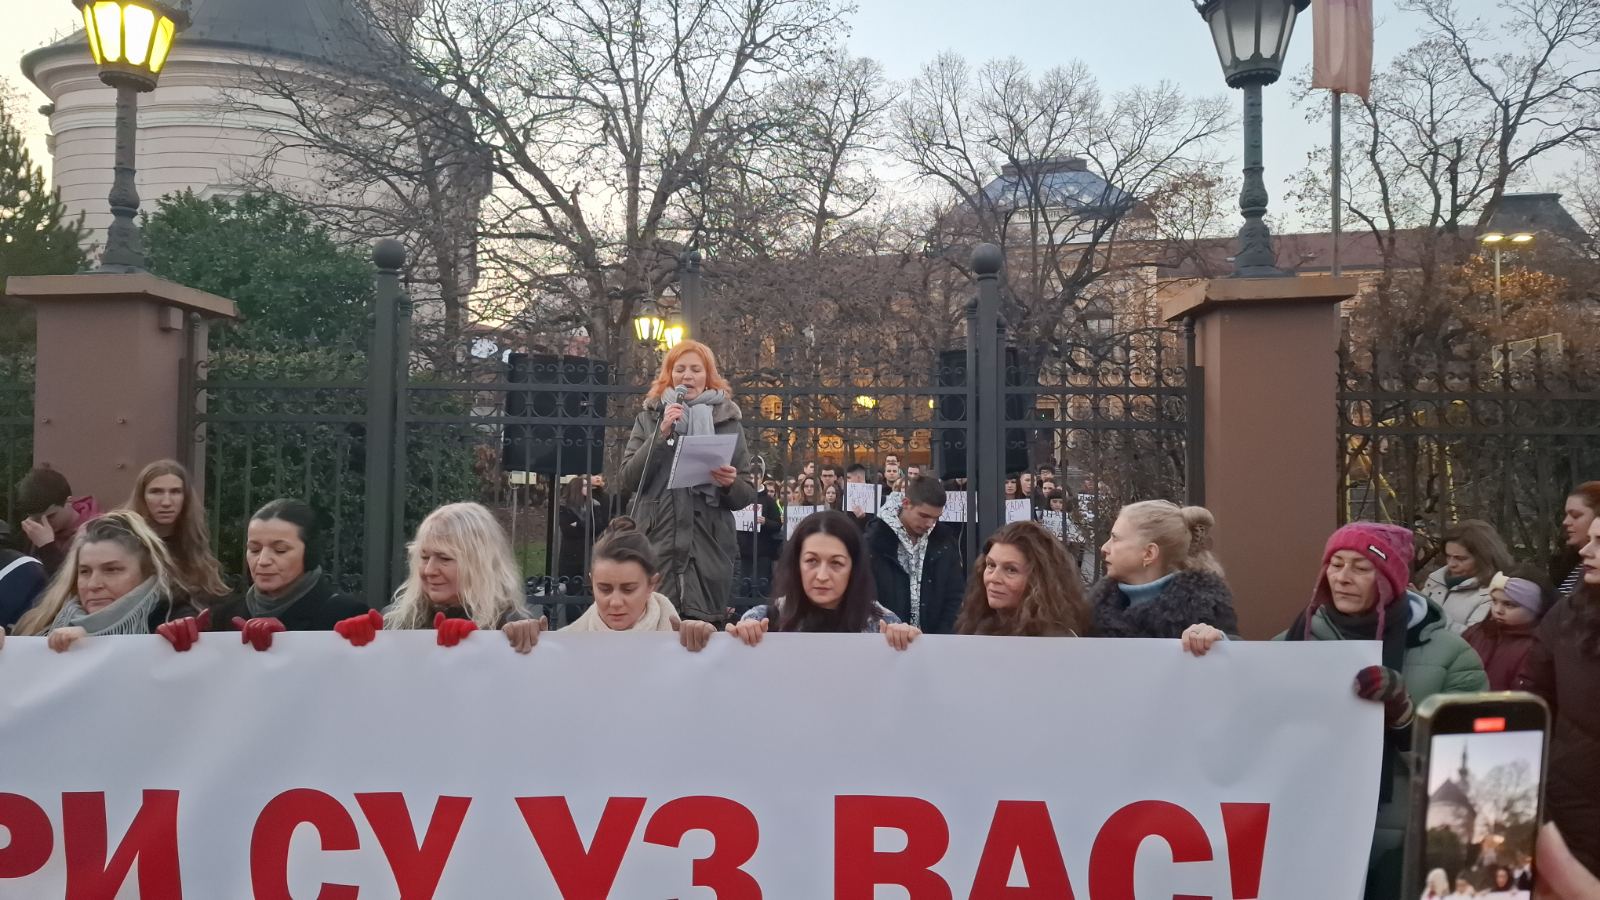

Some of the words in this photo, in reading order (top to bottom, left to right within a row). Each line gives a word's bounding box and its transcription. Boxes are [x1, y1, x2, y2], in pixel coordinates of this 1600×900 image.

[251, 789, 471, 900] СУ
[516, 795, 763, 900] УЗ
[835, 795, 1270, 900] ВАС!
